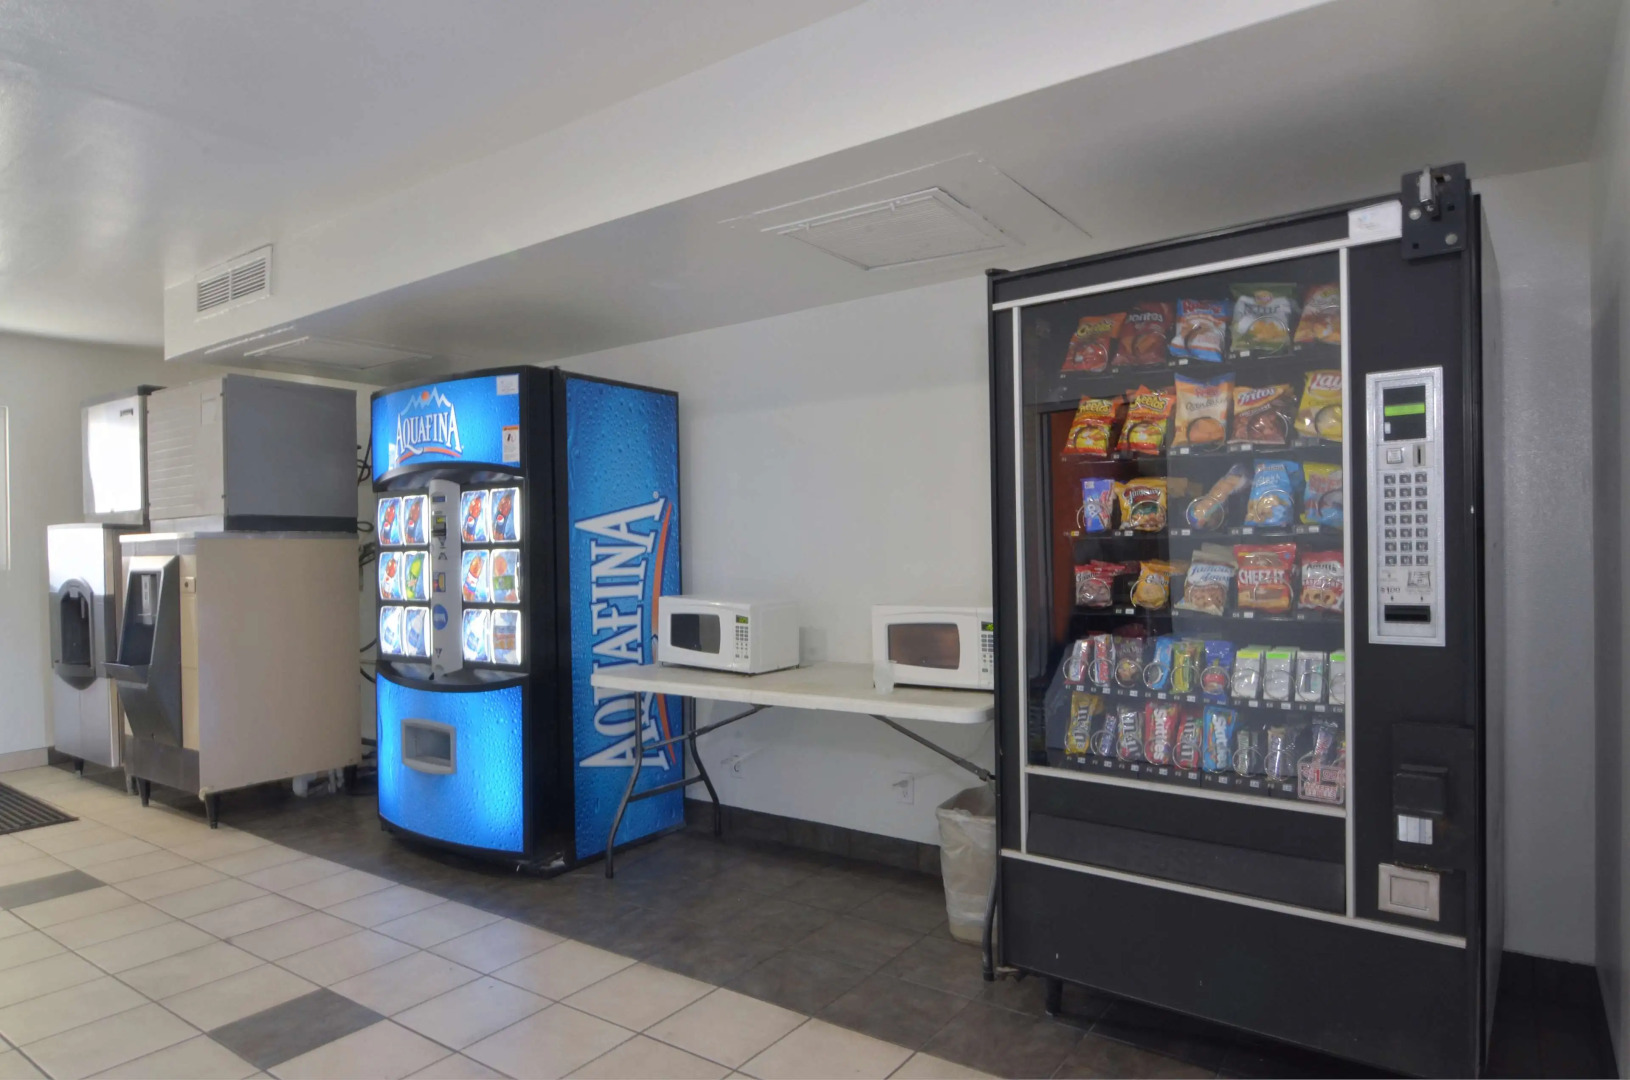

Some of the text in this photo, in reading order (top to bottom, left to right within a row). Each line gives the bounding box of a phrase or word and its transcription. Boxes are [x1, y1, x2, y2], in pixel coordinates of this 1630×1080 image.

[1237, 386, 1276, 405] Fritos
[1079, 399, 1110, 413] heetos
[395, 403, 462, 460] AQUAFINA
